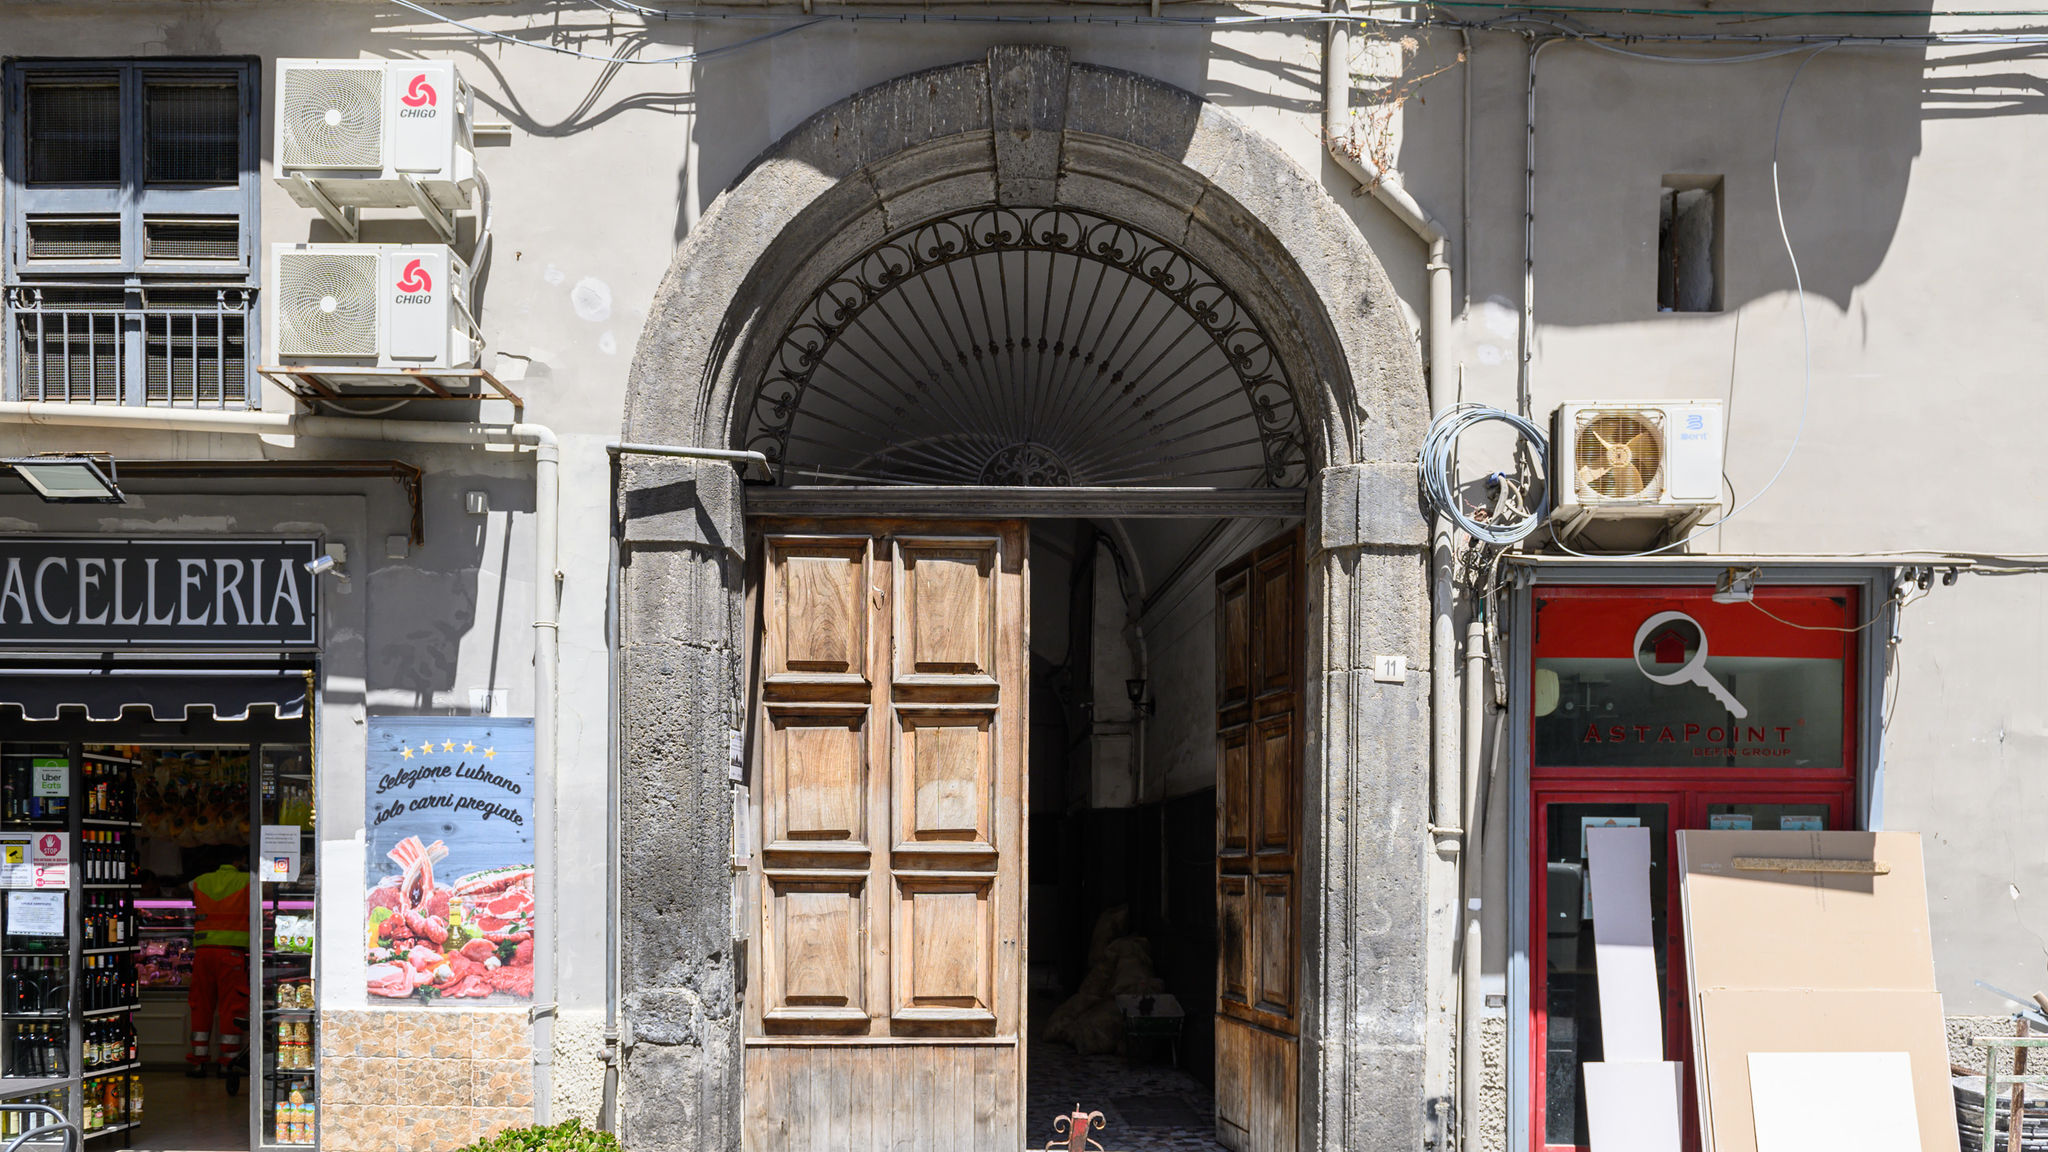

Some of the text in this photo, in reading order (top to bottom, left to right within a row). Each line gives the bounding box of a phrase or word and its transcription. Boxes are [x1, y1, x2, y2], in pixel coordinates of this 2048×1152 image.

[400, 109, 436, 118] CHIGO
[395, 295, 431, 304] CHIGO
[0, 556, 306, 626] ACELLERIA
[1384, 659, 1396, 676] 11
[1741, 748, 1791, 757] GROUP
[41, 773, 61, 781] Uber
[376, 761, 521, 795] Selezione Lubrano
[374, 794, 523, 826] solo carni pregiate
